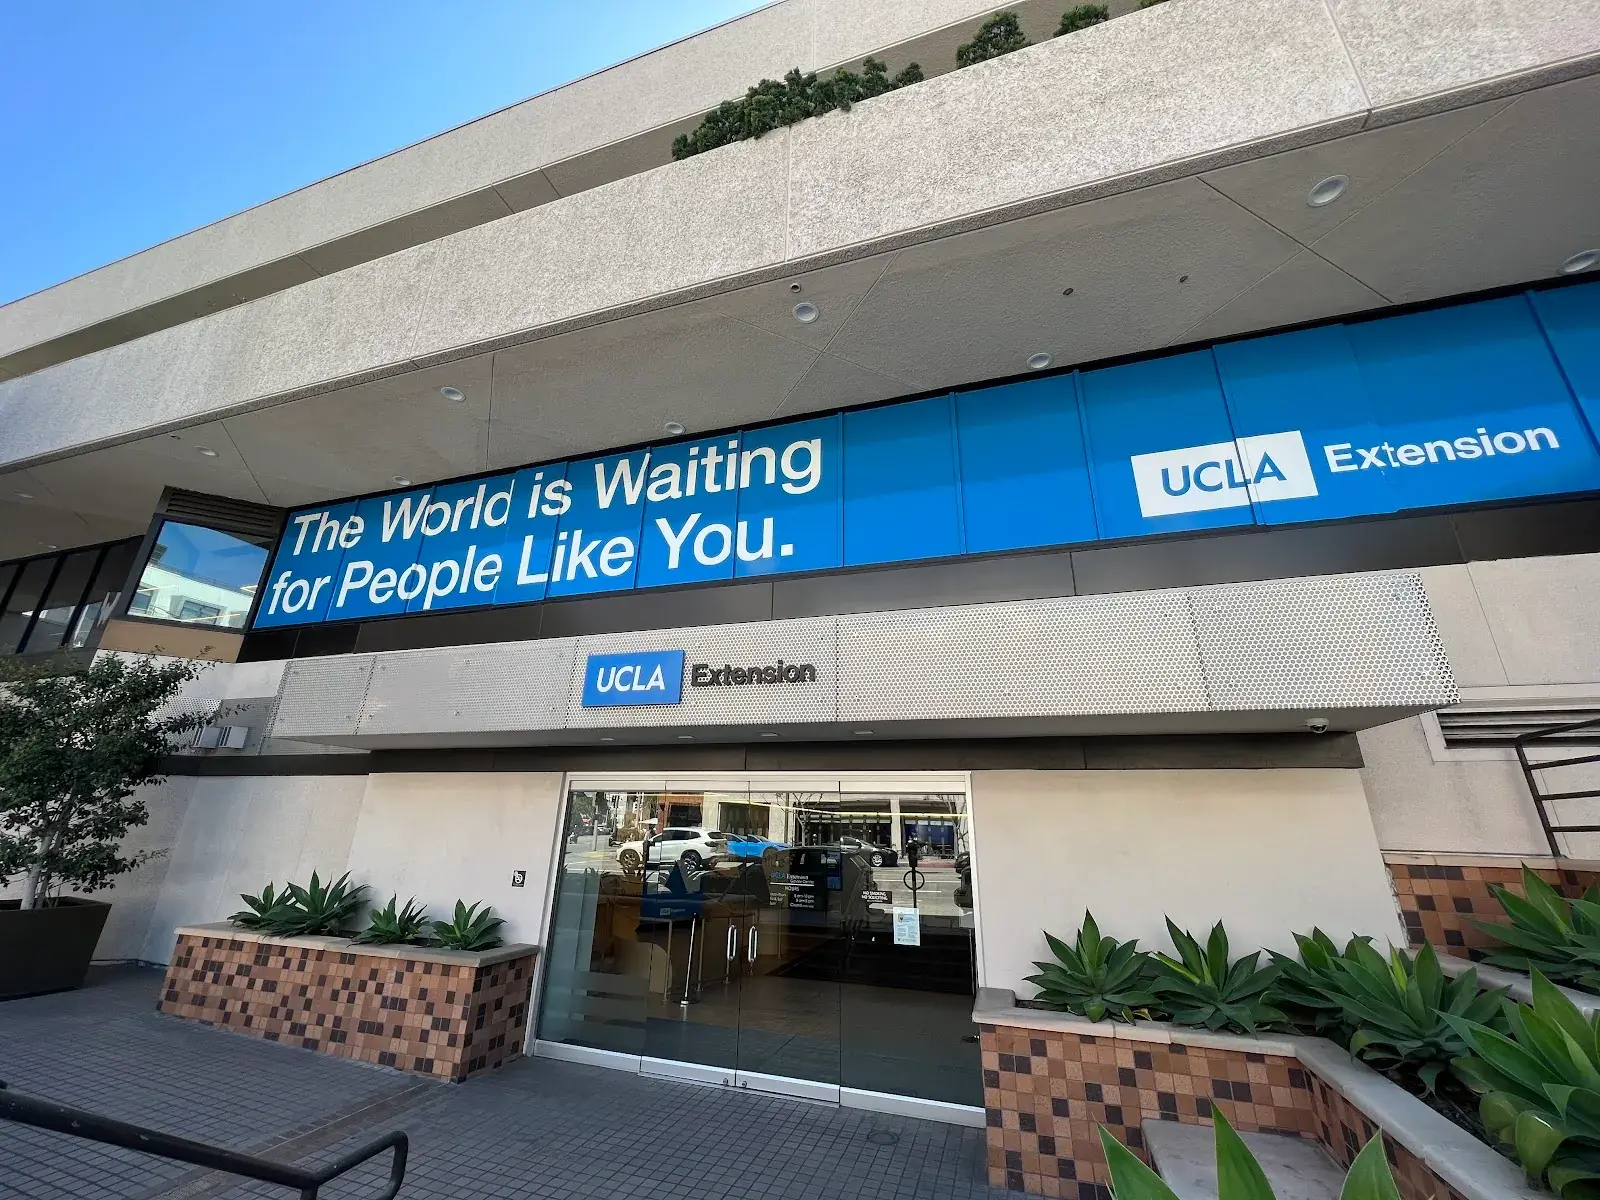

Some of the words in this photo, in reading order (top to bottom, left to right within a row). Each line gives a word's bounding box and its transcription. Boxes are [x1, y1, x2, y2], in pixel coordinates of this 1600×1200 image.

[293, 512, 365, 556] The
[381, 479, 515, 542] World
[527, 472, 573, 518] is
[594, 438, 822, 509] Waiting
[1161, 451, 1287, 497] UCLA
[1323, 426, 1560, 473] Extension
[267, 571, 332, 615] for
[336, 544, 503, 610] People
[516, 529, 635, 586] Like
[655, 511, 794, 569] You.
[596, 664, 666, 693] UCLA
[691, 660, 816, 687] Extension
